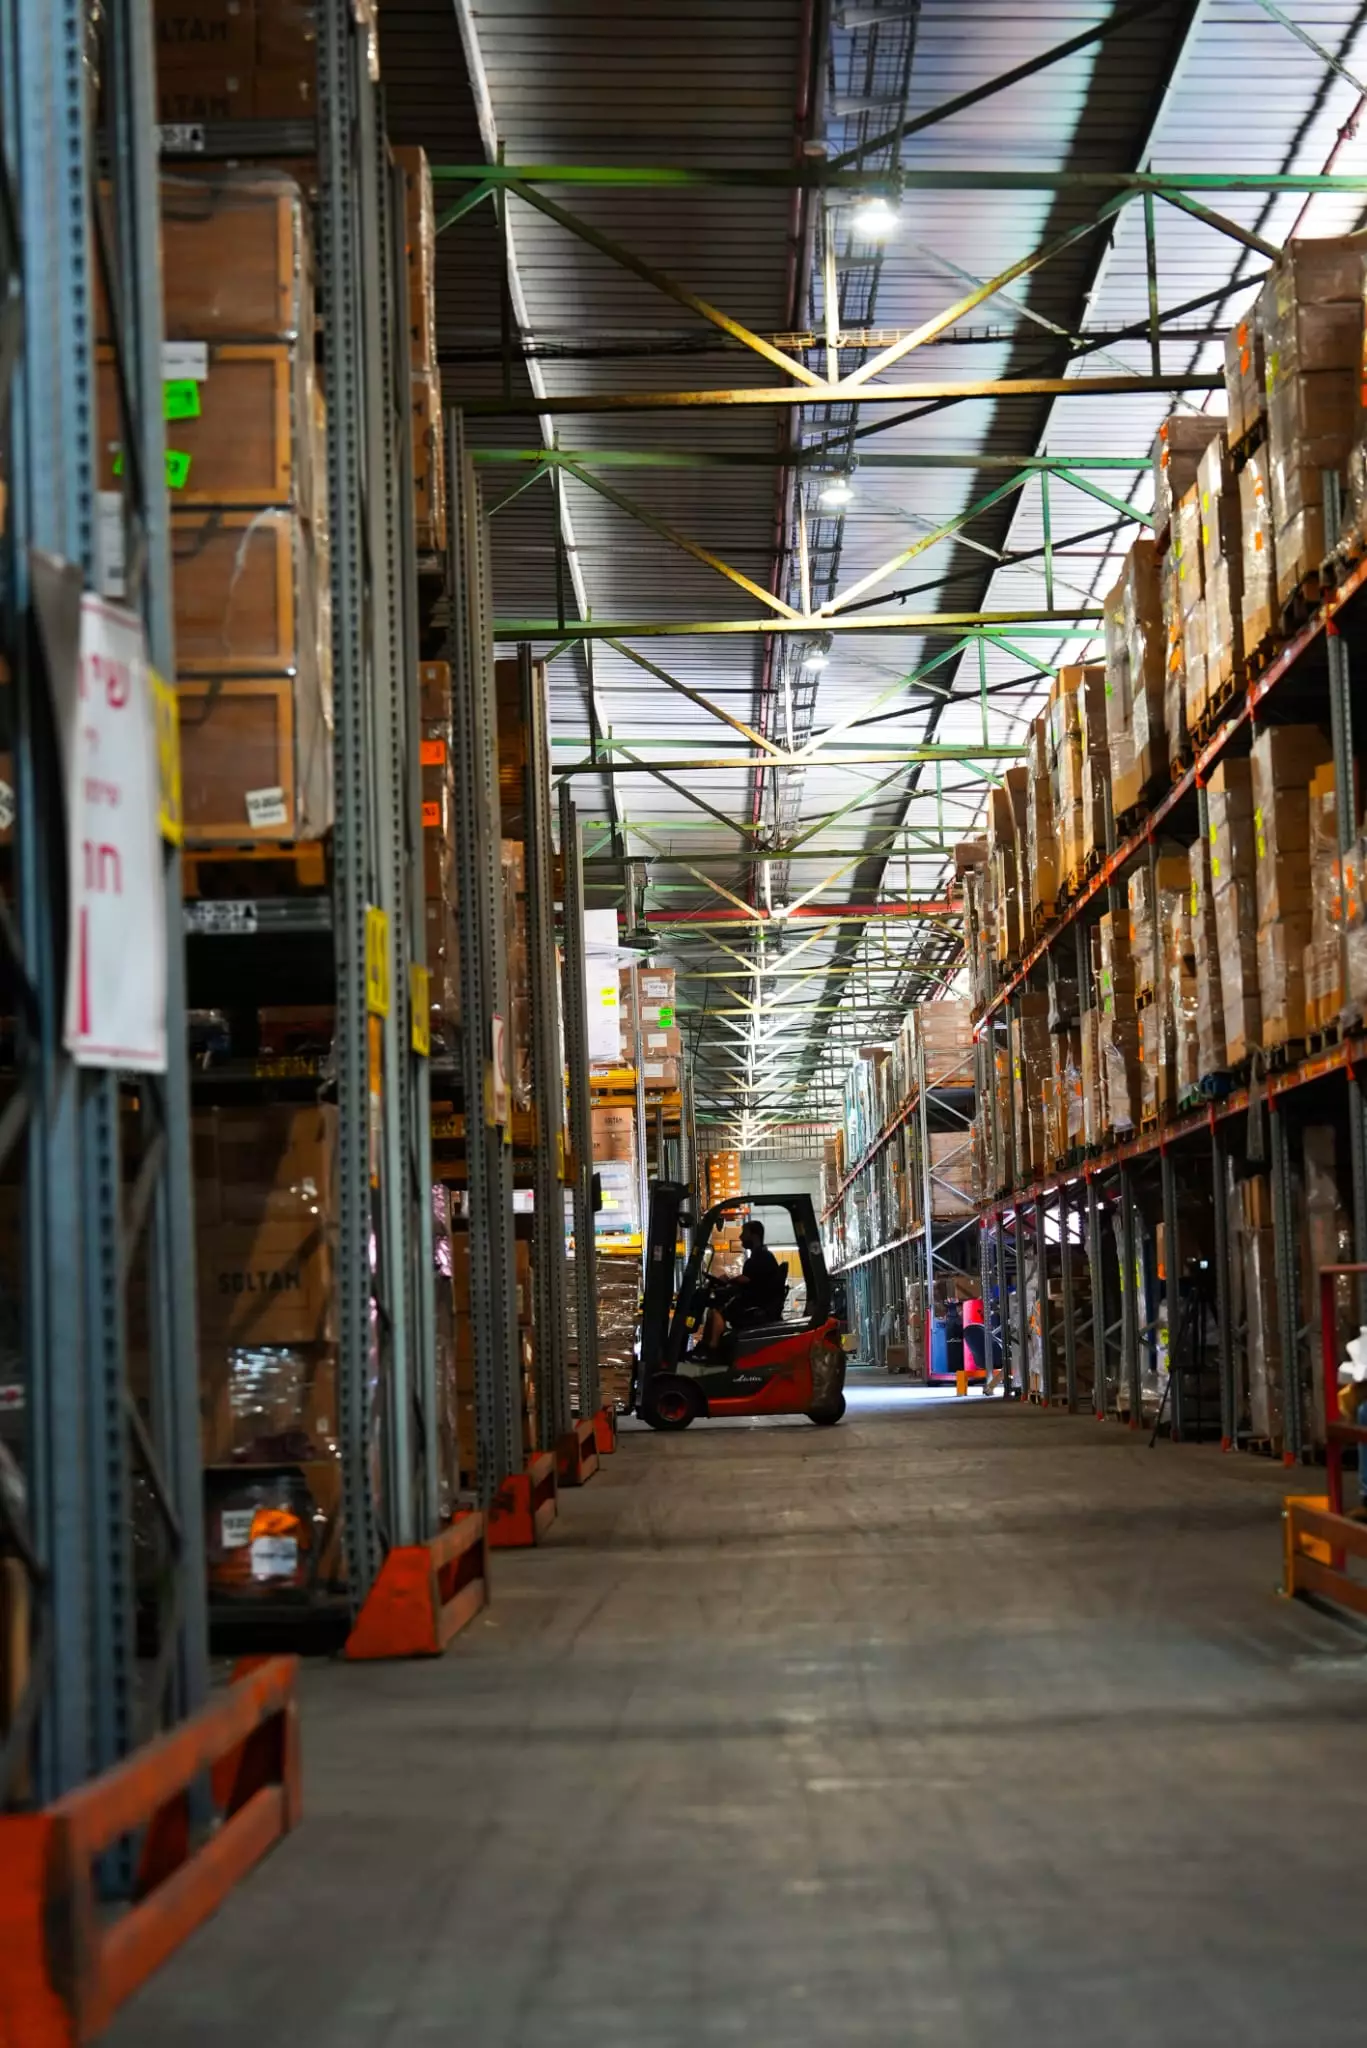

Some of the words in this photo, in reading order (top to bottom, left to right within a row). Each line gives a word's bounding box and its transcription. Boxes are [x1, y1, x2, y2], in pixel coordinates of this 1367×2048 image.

[160, 17, 228, 43] LTAM
[161, 94, 231, 119] LTAM
[217, 1271, 301, 1294] SOLTAM
